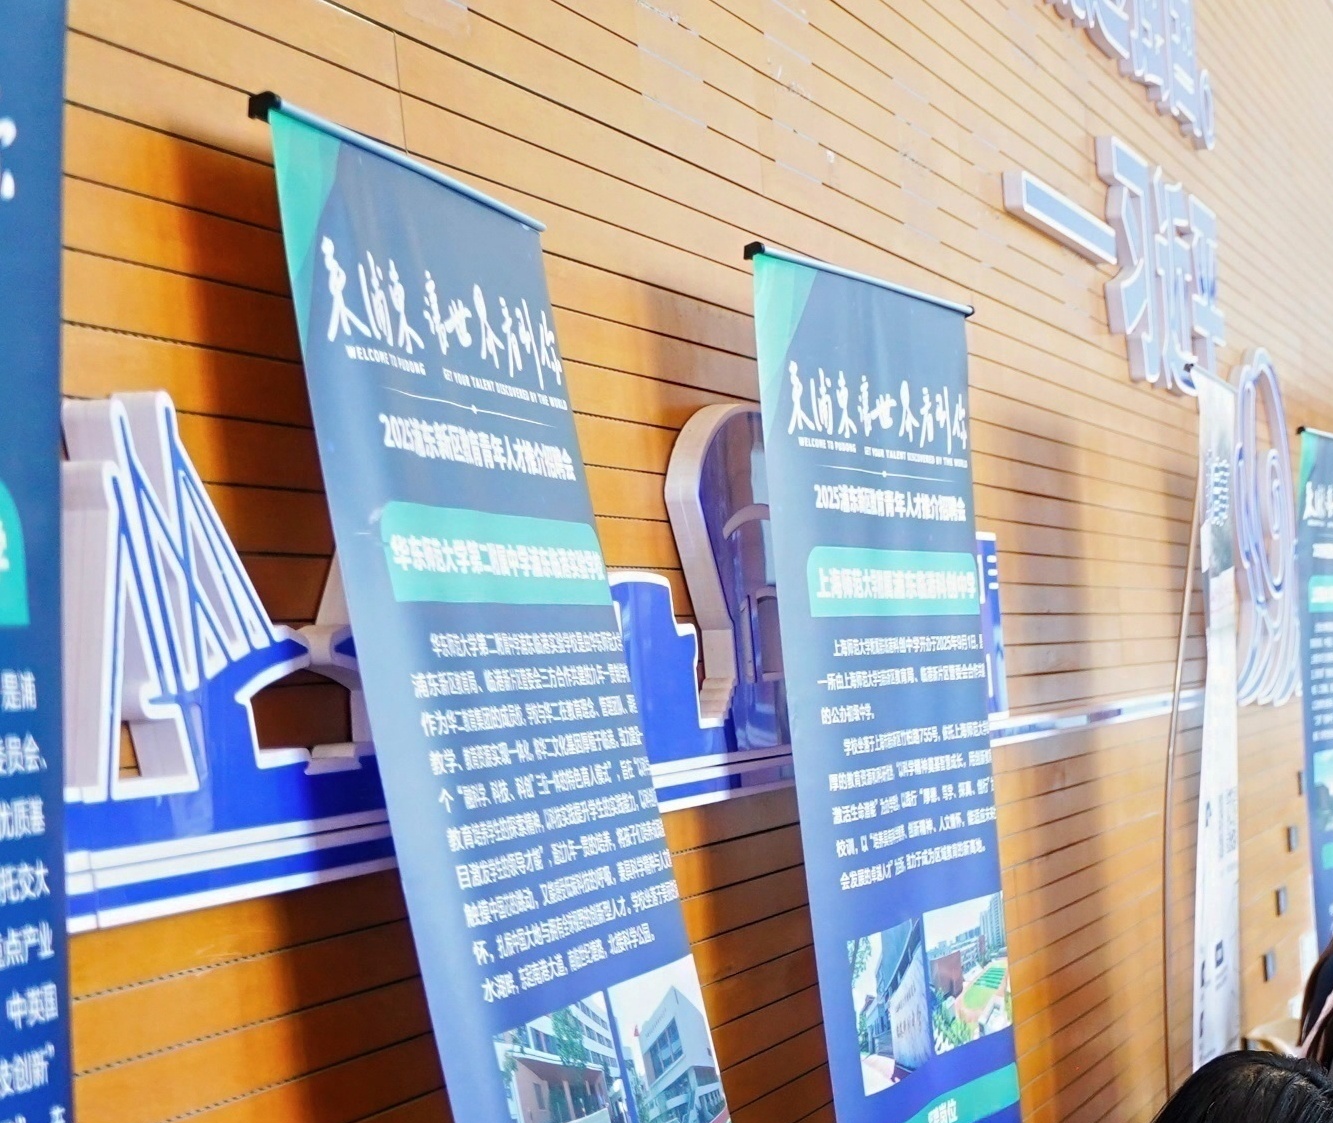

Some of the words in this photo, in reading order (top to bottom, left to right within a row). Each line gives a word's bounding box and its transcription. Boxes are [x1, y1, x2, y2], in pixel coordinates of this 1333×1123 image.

[344, 344, 390, 366] WELCOME
[471, 375, 495, 394] TALENT
[798, 436, 827, 450] WELCOME
